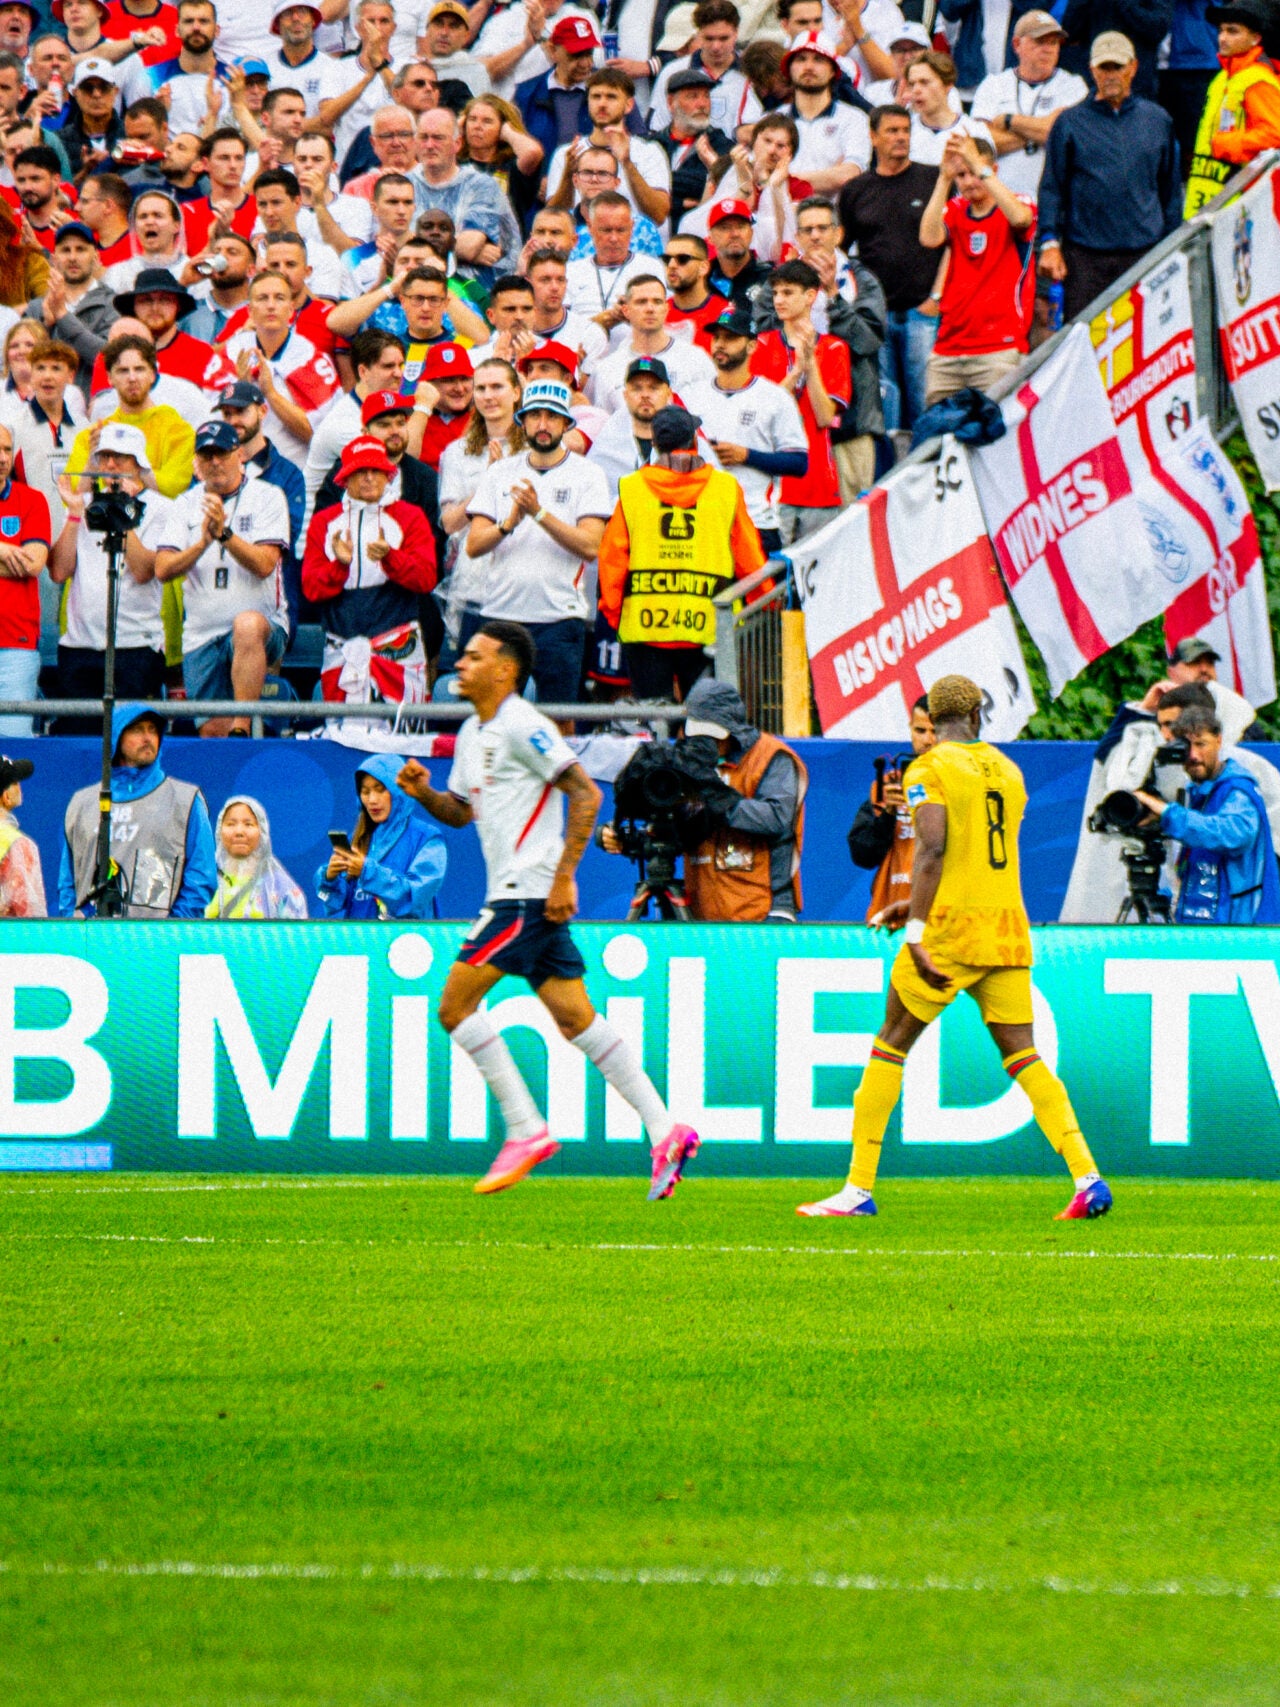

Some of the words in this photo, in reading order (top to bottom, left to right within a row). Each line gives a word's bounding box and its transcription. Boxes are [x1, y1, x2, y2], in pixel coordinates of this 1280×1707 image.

[1002, 460, 1110, 578] WIDNES
[631, 571, 718, 600] SECURITY
[639, 607, 707, 632] 02480
[985, 790, 1008, 871] 8
[177, 932, 1060, 1146] MiniLED
